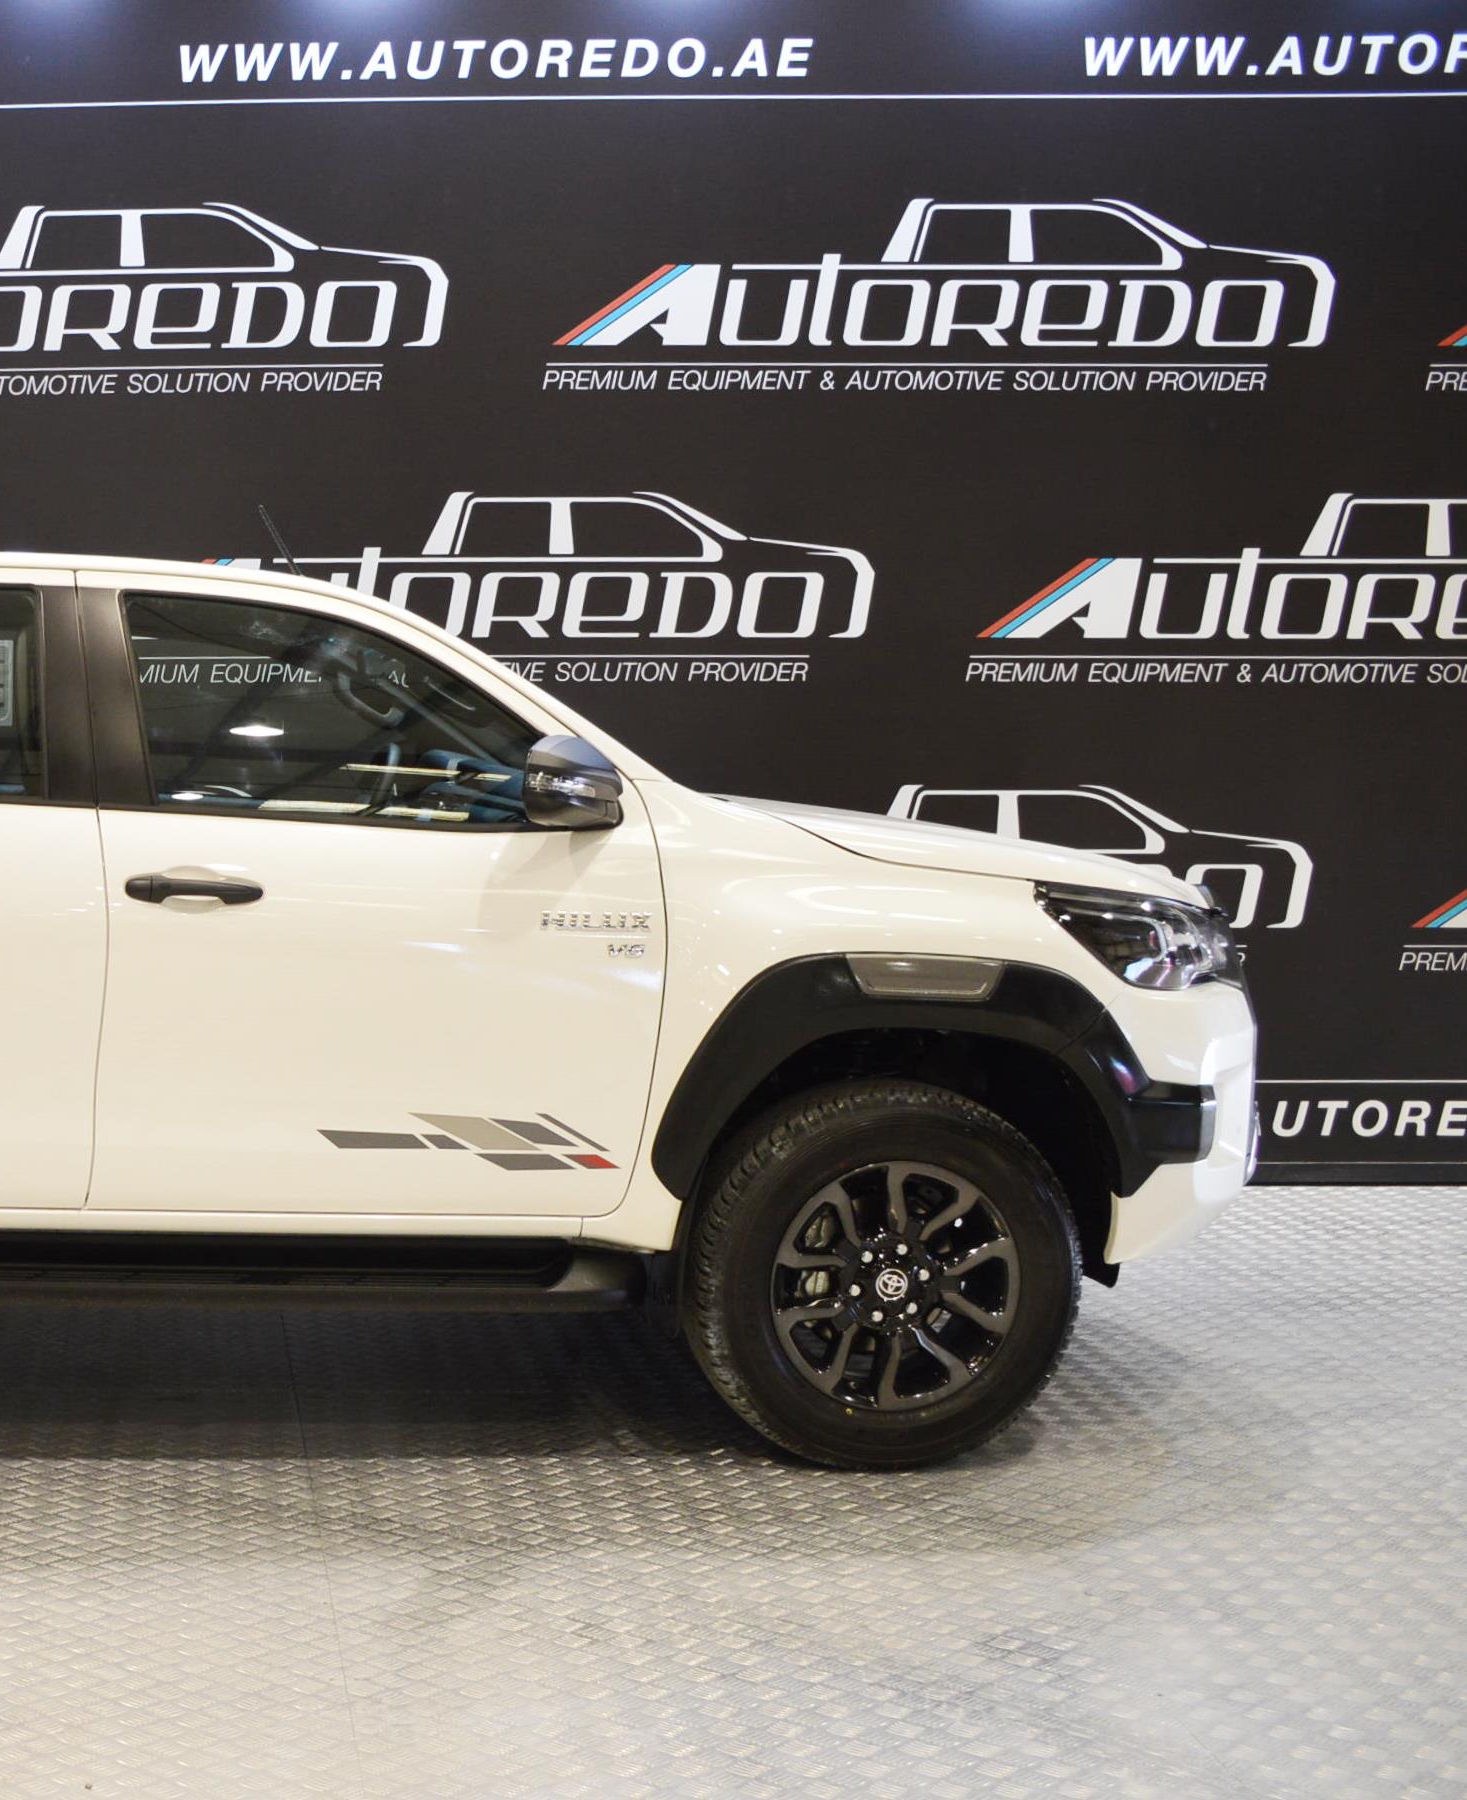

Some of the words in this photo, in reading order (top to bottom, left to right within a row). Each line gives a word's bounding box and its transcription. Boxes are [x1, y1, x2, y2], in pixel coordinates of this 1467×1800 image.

[179, 37, 814, 83] WWW.AUTOREDO.AE
[127, 372, 250, 394] SOLUTION
[261, 371, 382, 392] PROVIDER
[542, 370, 658, 391] PREMIUM
[667, 370, 811, 391] EQUIPMENT
[819, 370, 835, 391] &
[845, 370, 1004, 392] AUTOMOTIVE
[1012, 370, 1136, 391] SOLUTION
[1146, 371, 1267, 391] PROVIDER
[555, 662, 678, 682] SOLUTION
[688, 662, 809, 682] PROVIDER
[965, 662, 1078, 683] PREMIUM
[1087, 662, 1229, 683] EQUIPMENT
[1236, 663, 1251, 683] &
[1261, 663, 1419, 683] AUTOMOTIVE
[540, 910, 652, 931] HILUX
[1256, 1099, 1467, 1137] UTORE
